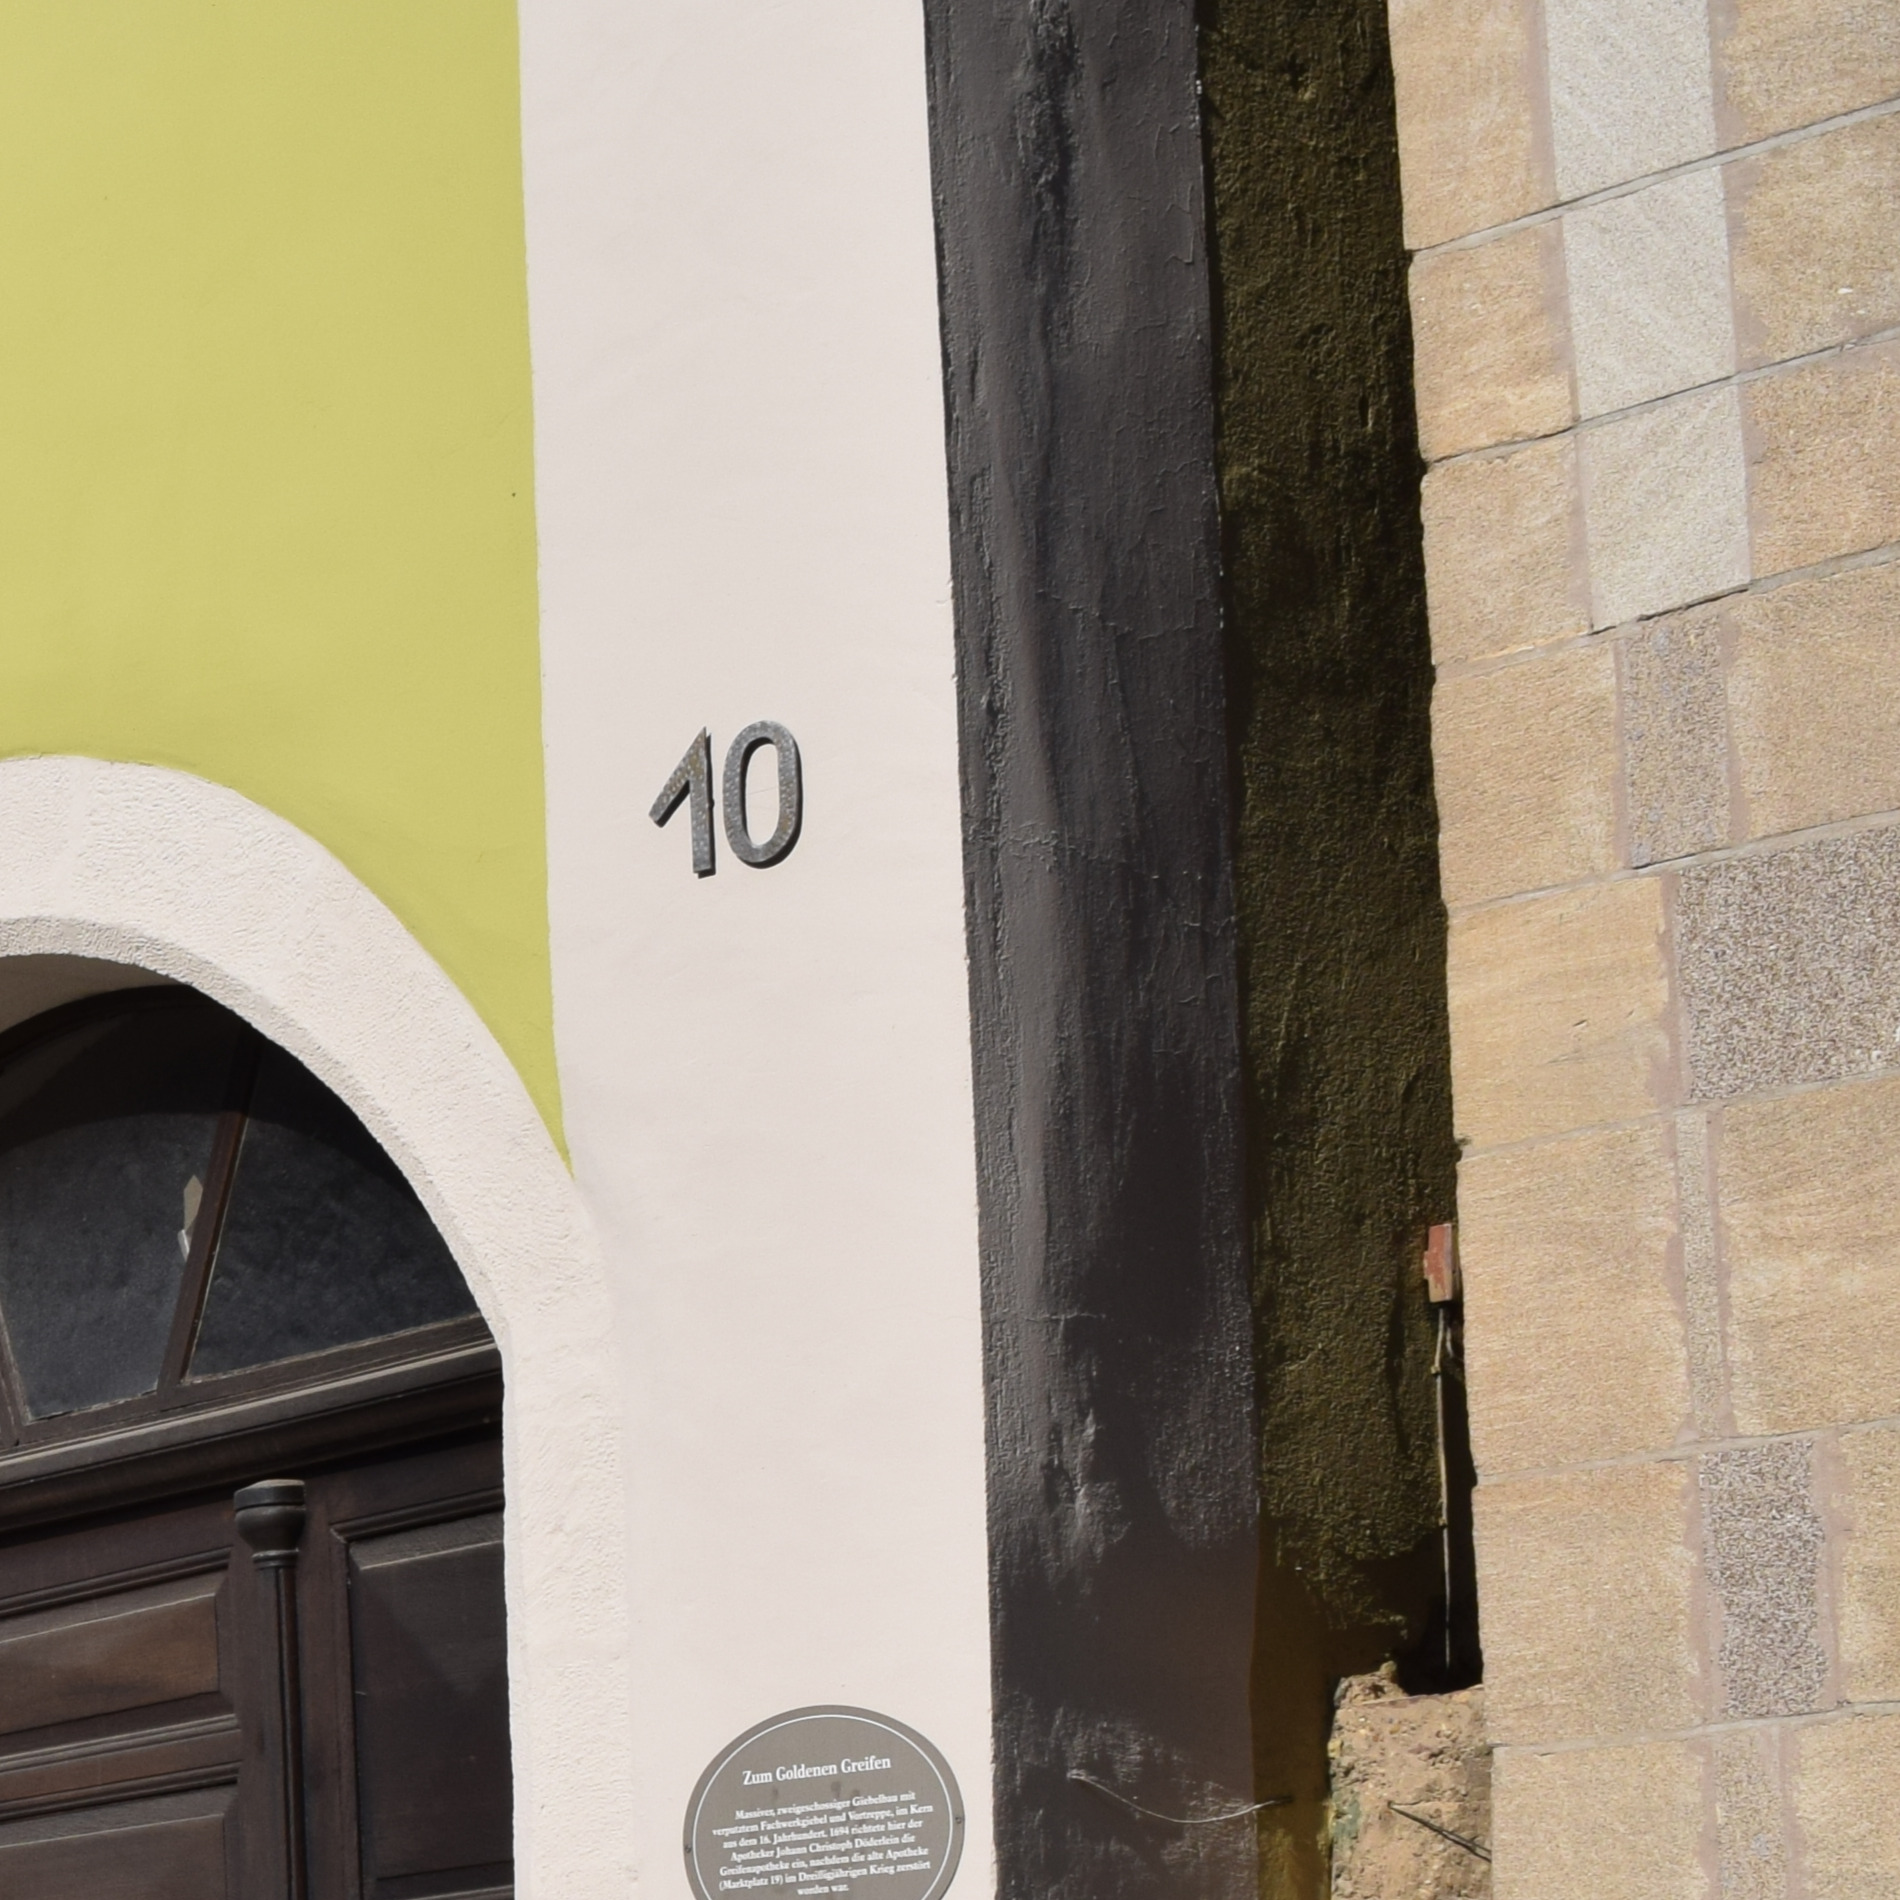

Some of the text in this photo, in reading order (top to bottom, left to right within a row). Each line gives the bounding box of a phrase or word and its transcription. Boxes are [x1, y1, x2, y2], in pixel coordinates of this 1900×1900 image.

[648, 720, 802, 876] 10
[742, 1755, 892, 1785] Zum Goldenen Greifen
[900, 1790, 916, 1801] mit
[760, 1815, 828, 1830] Fachwerkgiebel
[829, 1811, 847, 1823] und
[895, 1805, 909, 1816] im
[909, 1803, 934, 1815] Kern
[722, 1840, 738, 1849] aus
[738, 1837, 758, 1847] dem
[829, 1825, 850, 1837] 1694
[851, 1823, 886, 1835] richtete
[887, 1819, 906, 1831] hier
[907, 1818, 923, 1829] der
[730, 1848, 775, 1863] Apotheker
[775, 1846, 808, 1858] Johann
[808, 1840, 853, 1853] Christoph
[900, 1832, 916, 1843] die
[719, 1860, 790, 1876] Greifenapotheke
[809, 1855, 850, 1867] nachdem
[851, 1852, 866, 1863] die
[866, 1850, 884, 1861] alte
[885, 1846, 929, 1861] Apotheke
[869, 1863, 895, 1876] Krieg
